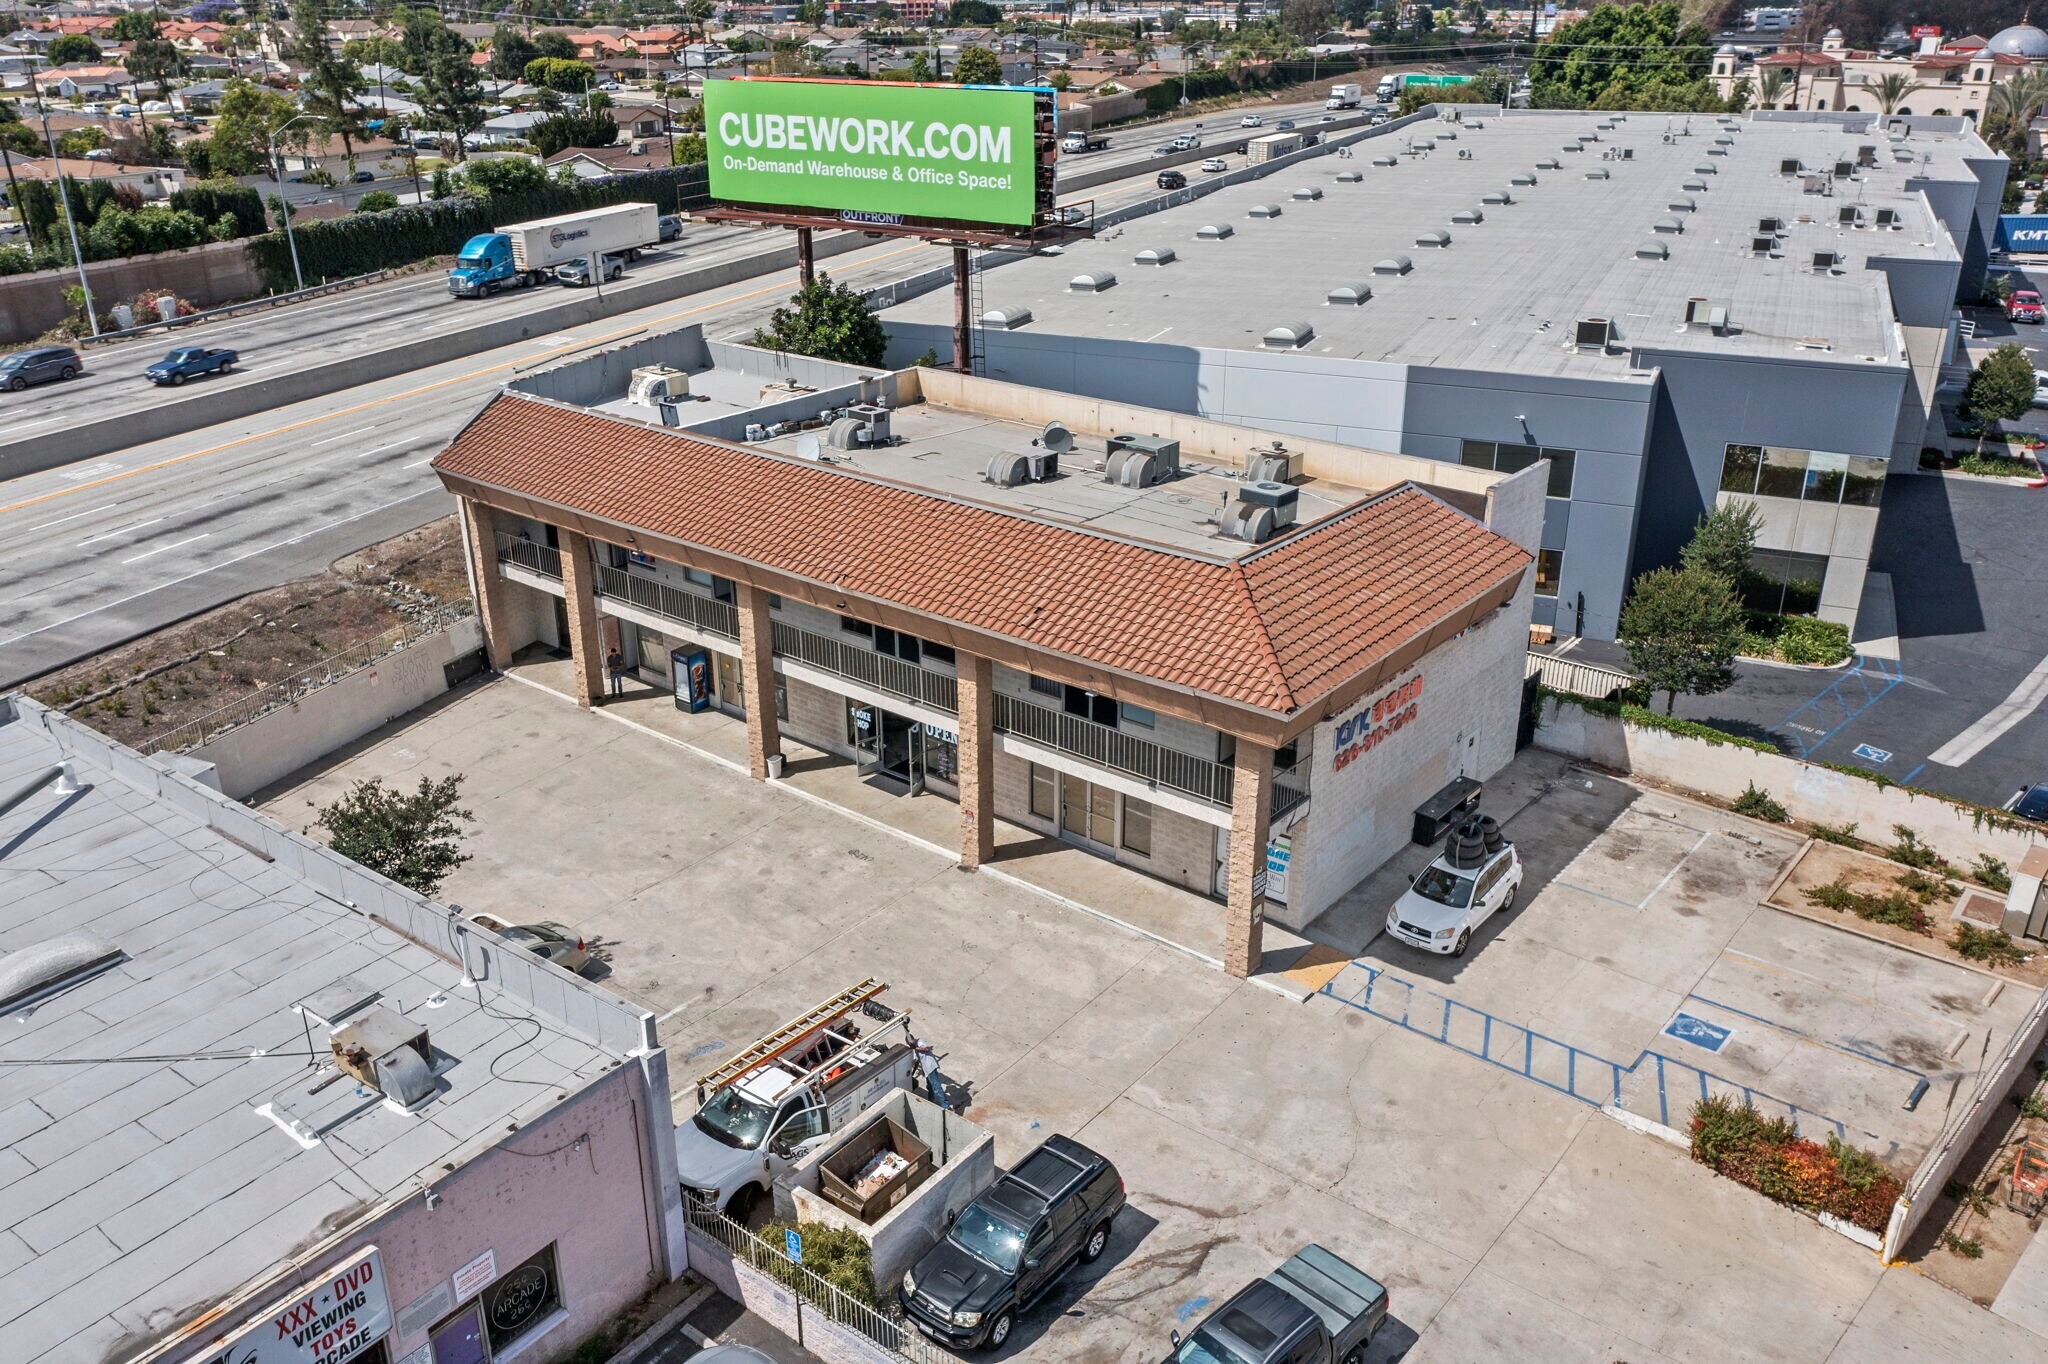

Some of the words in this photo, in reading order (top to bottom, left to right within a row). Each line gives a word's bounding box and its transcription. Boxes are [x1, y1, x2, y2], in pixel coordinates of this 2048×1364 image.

[719, 112, 1011, 163] CUBEWORK.COM
[723, 155, 803, 174] On-Demand
[807, 160, 888, 180] Warehouse
[892, 166, 903, 181] &
[908, 167, 954, 184] Office
[958, 170, 1012, 190] Space!
[842, 209, 900, 223] OUTFRONT
[274, 1297, 318, 1341] XXX
[334, 1261, 373, 1301] DVD
[497, 1278, 542, 1317] ARCADE
[292, 1291, 367, 1348] VIEWING
[310, 1317, 357, 1357] TOYS
